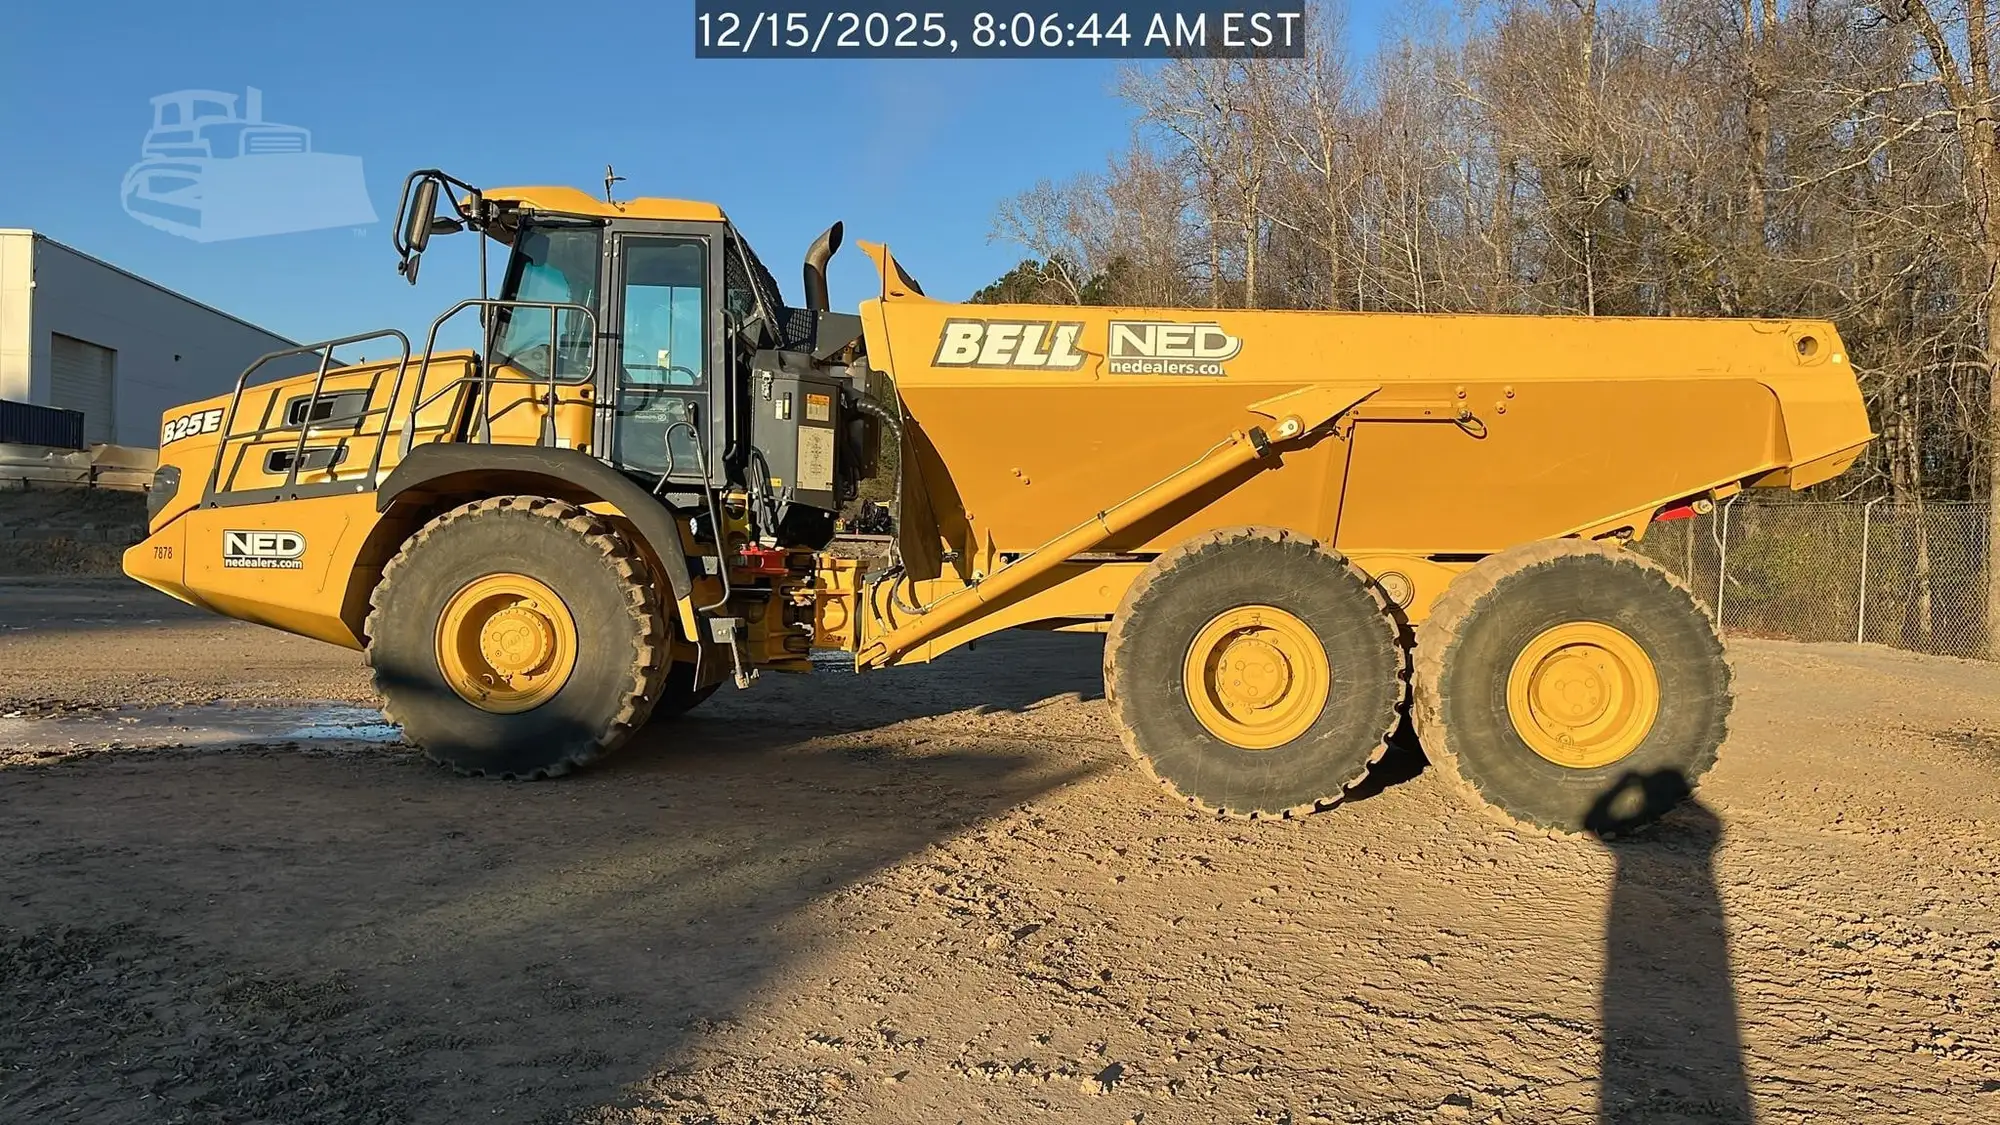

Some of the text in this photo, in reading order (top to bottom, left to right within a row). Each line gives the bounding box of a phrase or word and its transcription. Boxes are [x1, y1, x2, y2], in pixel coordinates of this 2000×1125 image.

[932, 320, 1085, 370] BELL
[1111, 322, 1240, 359] NED
[161, 408, 224, 446] B25E
[153, 546, 173, 560] 7878
[225, 531, 305, 556] NED
[225, 557, 303, 569] nedealers.com
